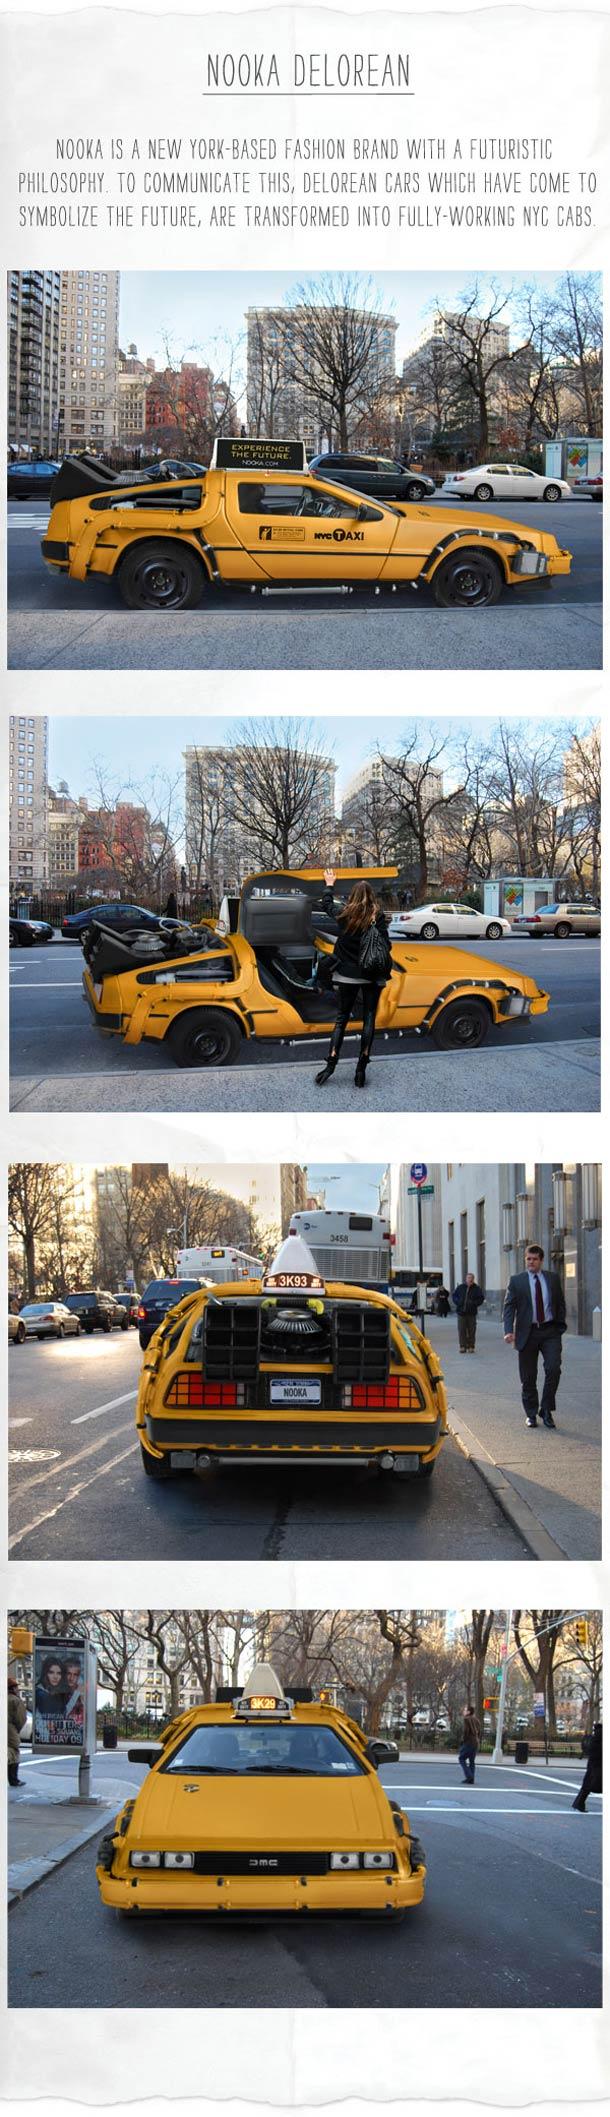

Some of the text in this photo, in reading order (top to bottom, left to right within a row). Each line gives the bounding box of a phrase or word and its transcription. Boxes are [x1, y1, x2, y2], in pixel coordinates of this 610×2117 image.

[231, 444, 291, 453] EXPERIENCE
[231, 451, 292, 460] THE FUTURE.
[330, 1234, 349, 1243] 3458
[279, 1275, 307, 1287] 3K93
[283, 1387, 307, 1397] NOOKA
[250, 1697, 276, 1709] 3K29
